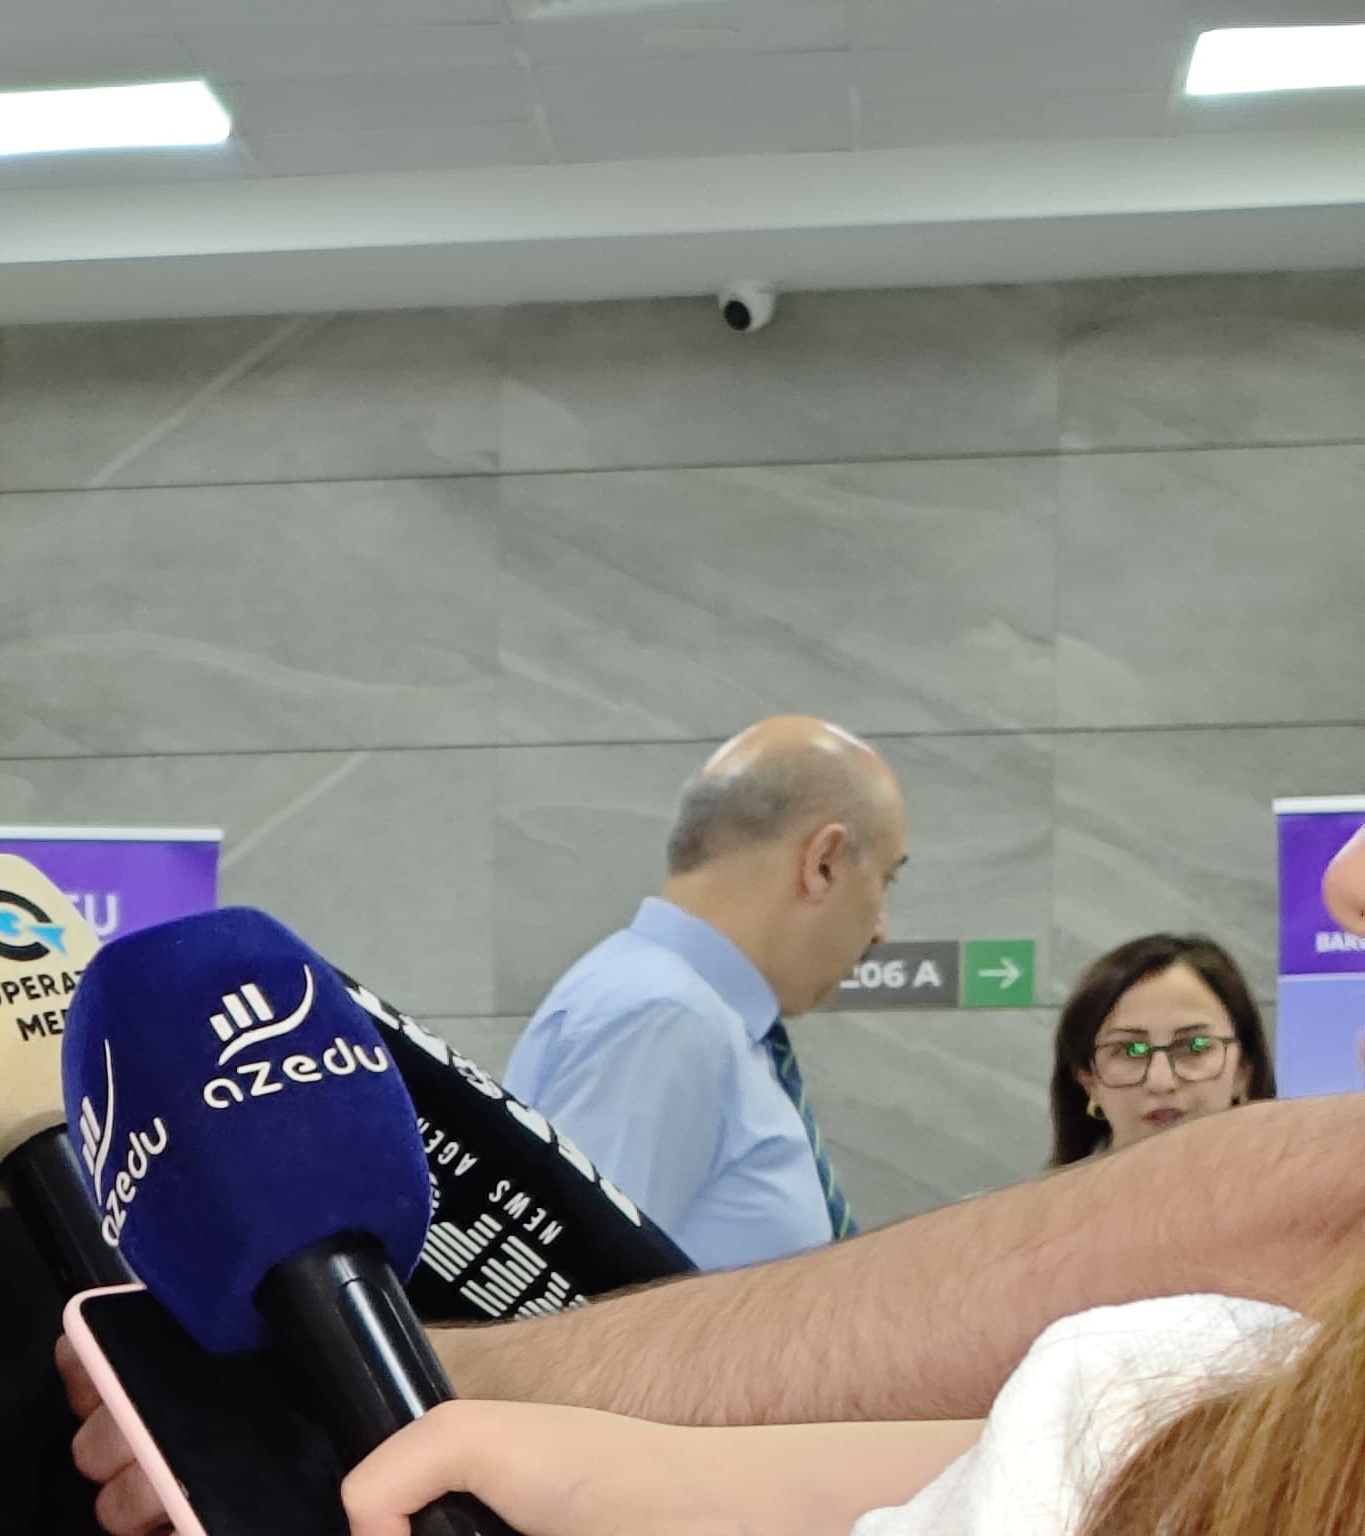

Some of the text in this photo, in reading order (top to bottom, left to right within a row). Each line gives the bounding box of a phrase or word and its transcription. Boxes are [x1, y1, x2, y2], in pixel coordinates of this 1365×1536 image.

[912, 960, 942, 987] A
[203, 1037, 388, 1108] azedu
[101, 1116, 168, 1247] azedu
[488, 1180, 563, 1245] NEWS
